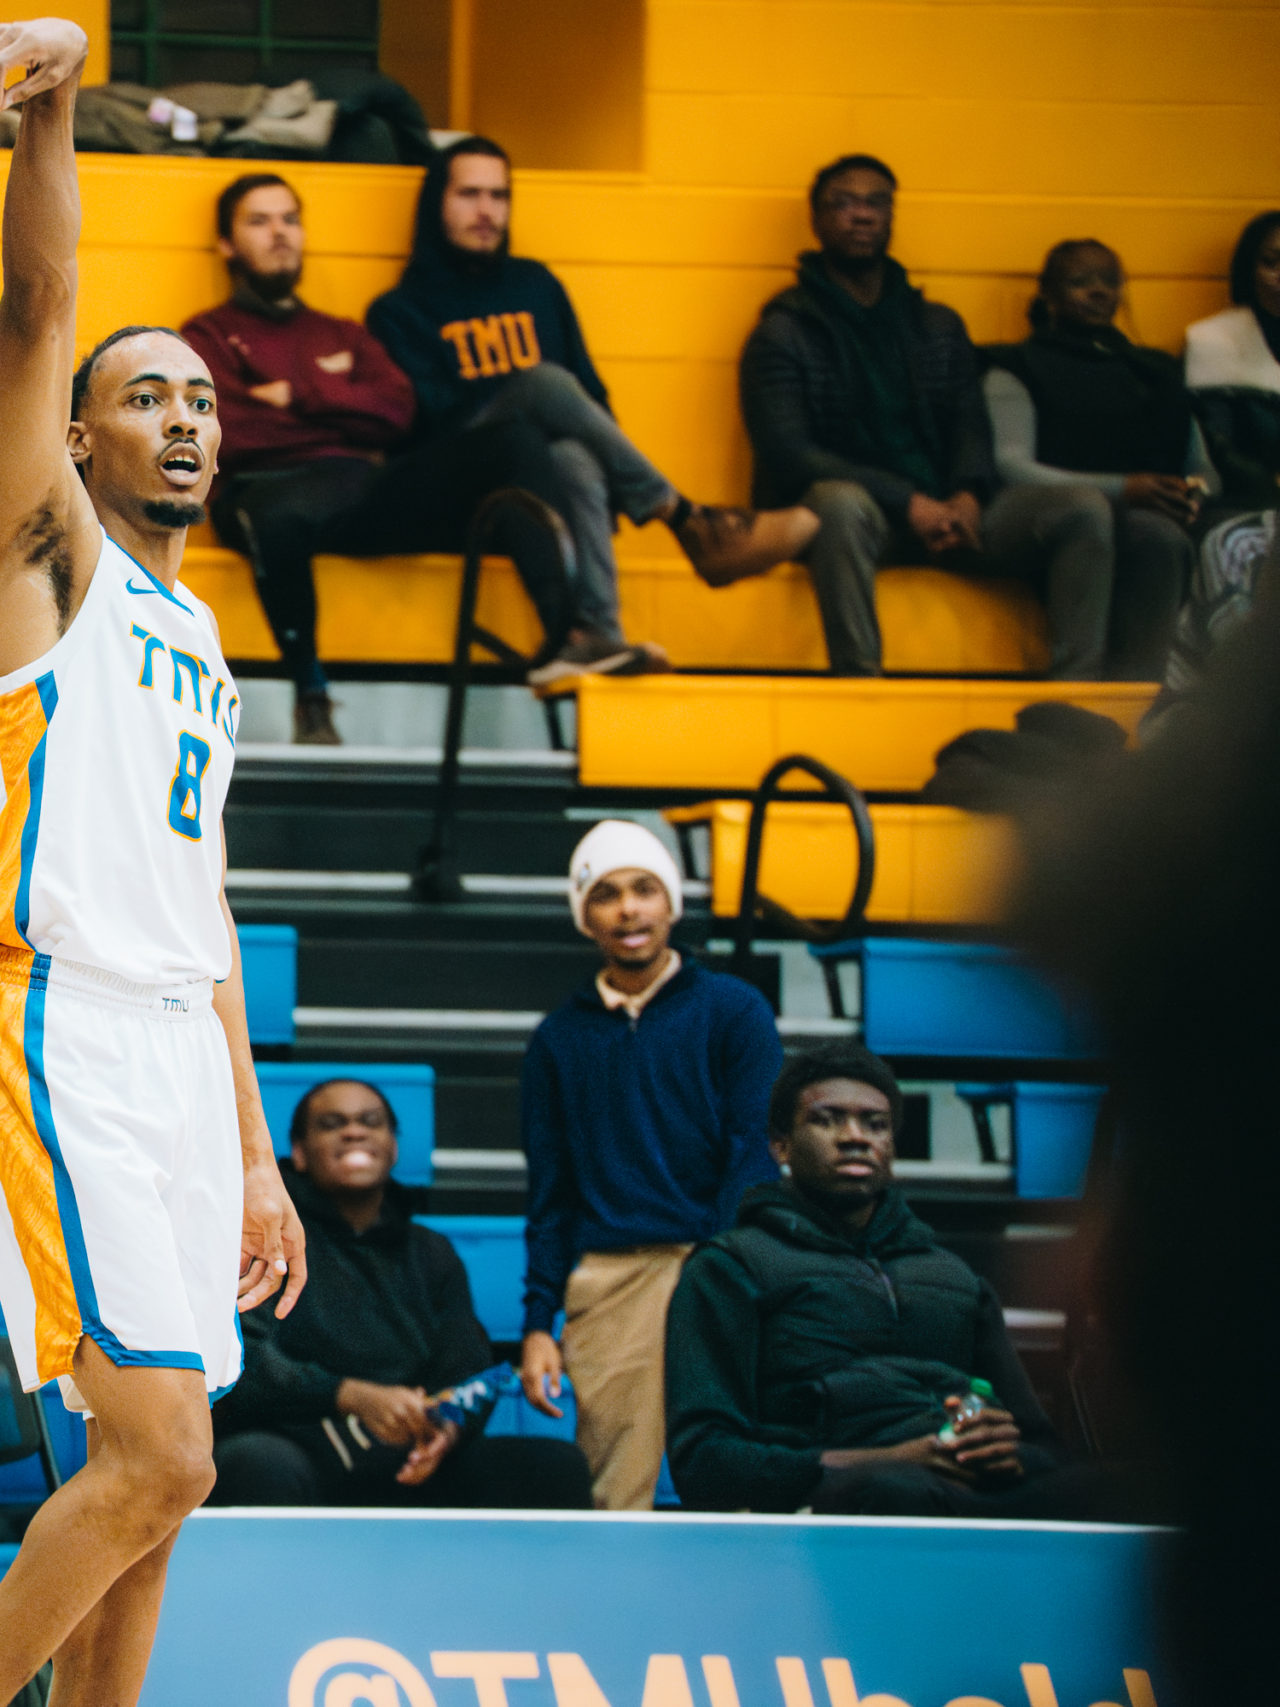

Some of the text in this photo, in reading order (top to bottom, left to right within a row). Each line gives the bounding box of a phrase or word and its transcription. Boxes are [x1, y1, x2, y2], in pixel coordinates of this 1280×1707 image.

[440, 310, 541, 380] TMU
[129, 620, 239, 750] TMU
[166, 729, 212, 842] 8
[162, 997, 190, 1013] TMU
